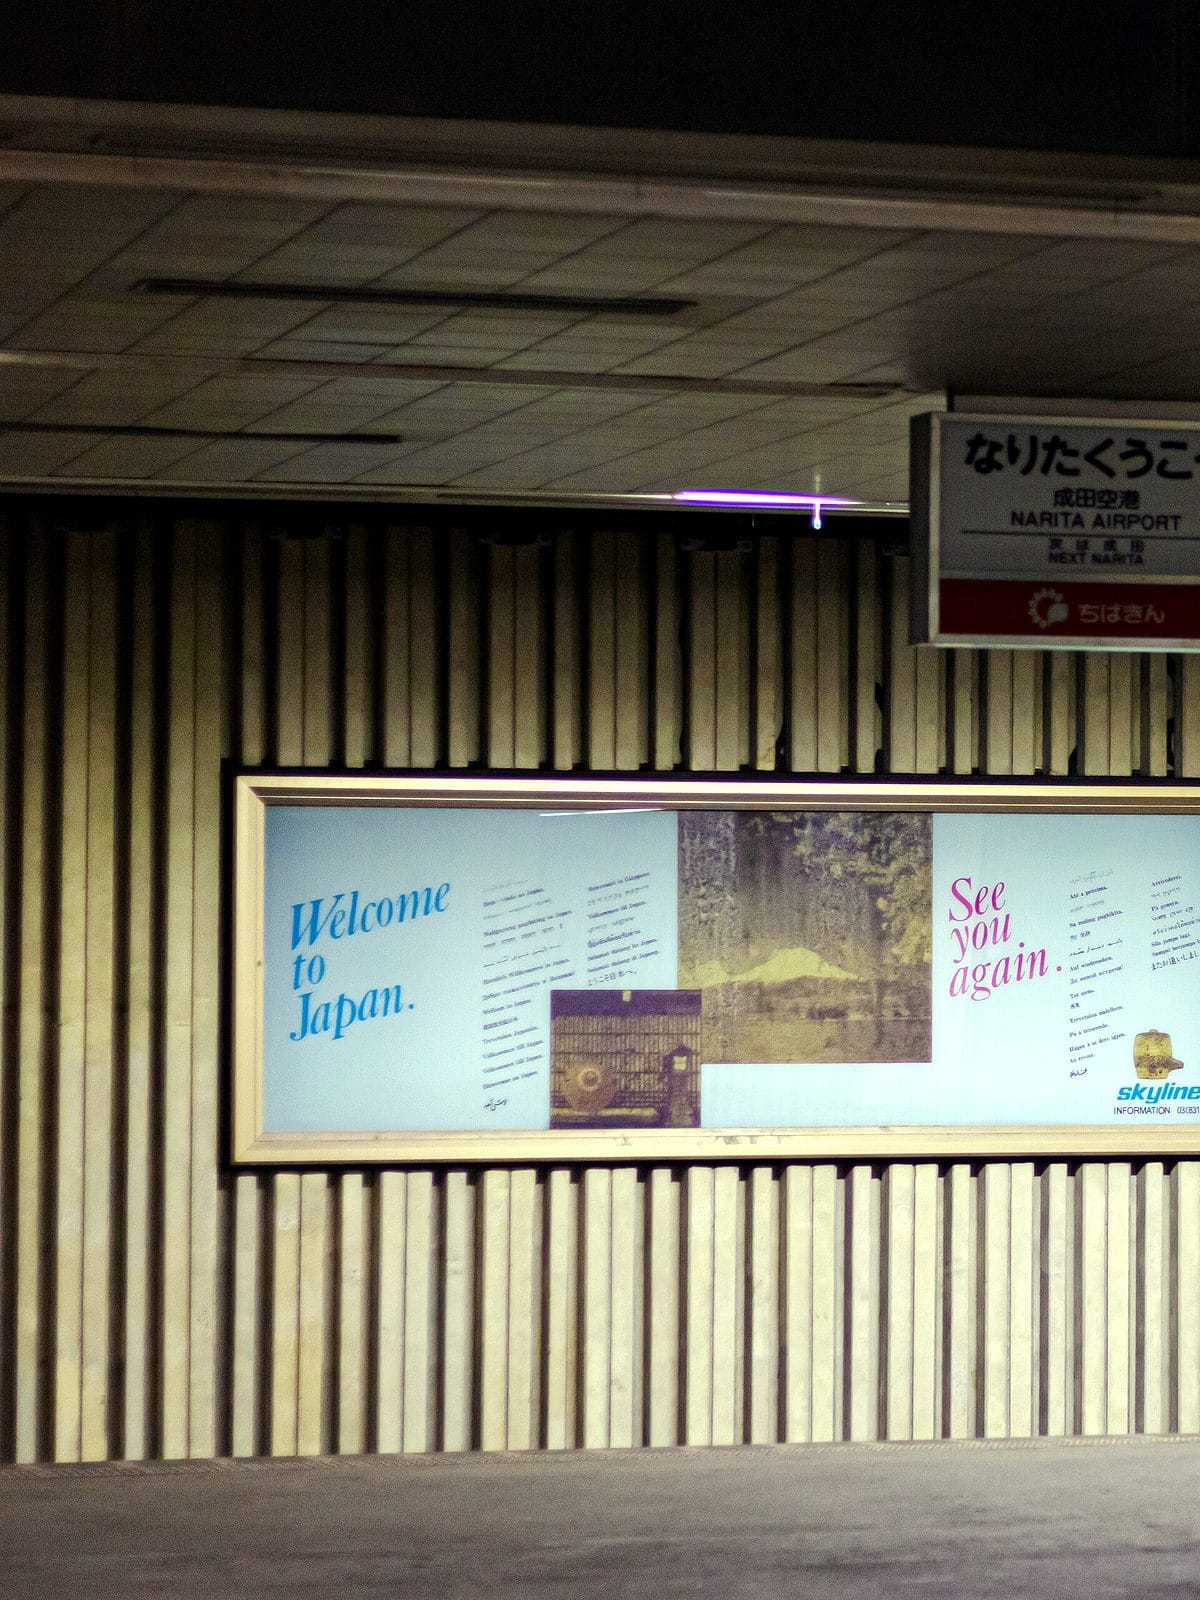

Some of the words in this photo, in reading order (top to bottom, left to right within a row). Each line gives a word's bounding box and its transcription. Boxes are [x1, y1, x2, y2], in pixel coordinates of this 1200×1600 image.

[1053, 487, 1140, 510] 成田空港
[1011, 511, 1085, 528] NARITA
[1092, 512, 1181, 531] AIRPORT
[1048, 553, 1088, 564] NEXT
[1091, 554, 1144, 565] NARITA
[291, 883, 450, 950] Welcome
[949, 877, 1006, 922] See
[950, 913, 1012, 963] you
[293, 953, 325, 990] to
[949, 941, 1062, 1001] again.
[290, 984, 415, 1041] Japan.
[1113, 1106, 1171, 1115] INFORMATION
